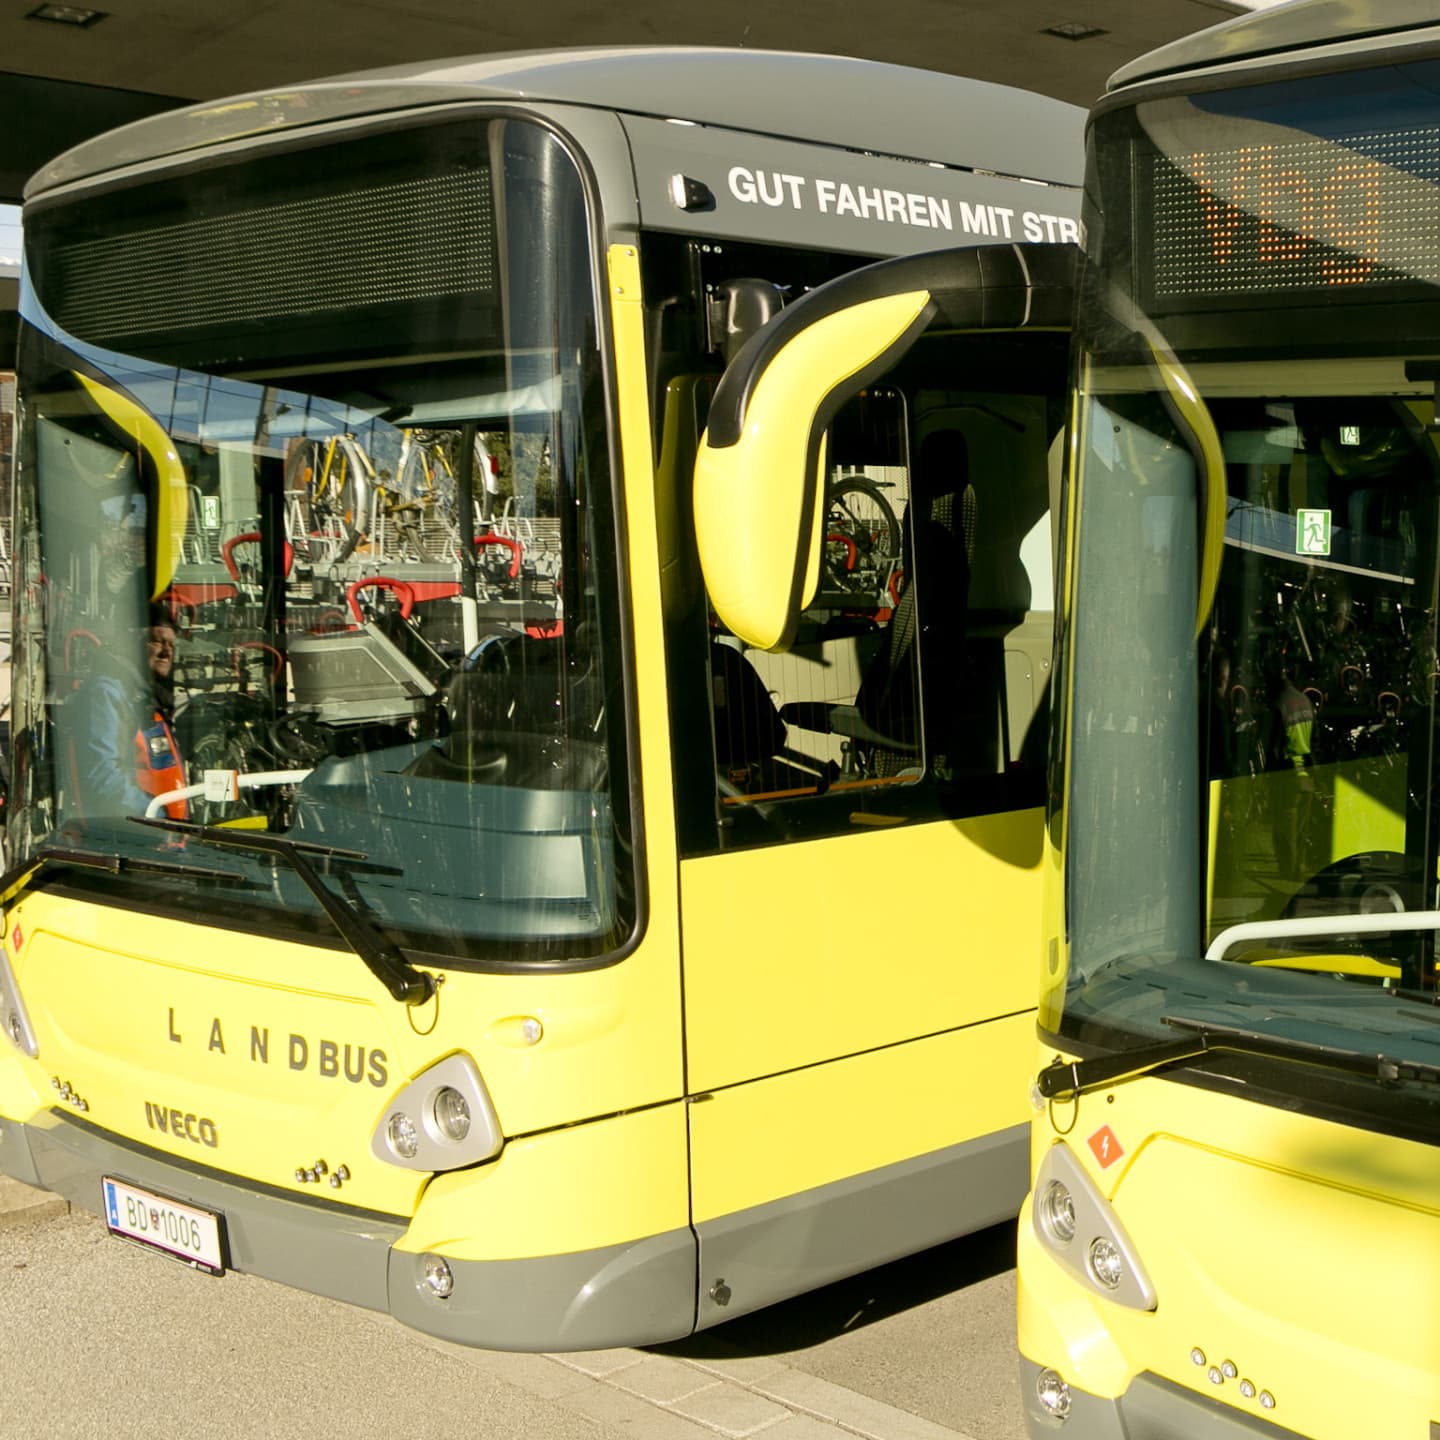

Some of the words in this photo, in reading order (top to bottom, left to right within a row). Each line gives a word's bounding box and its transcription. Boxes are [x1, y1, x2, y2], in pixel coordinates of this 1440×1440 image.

[728, 166, 805, 210] GUT
[816, 179, 953, 231] FAHREN
[959, 201, 1015, 239] MIT
[144, 1101, 218, 1148] IVECO
[126, 1196, 148, 1231] BD
[160, 1208, 202, 1251] 1006
